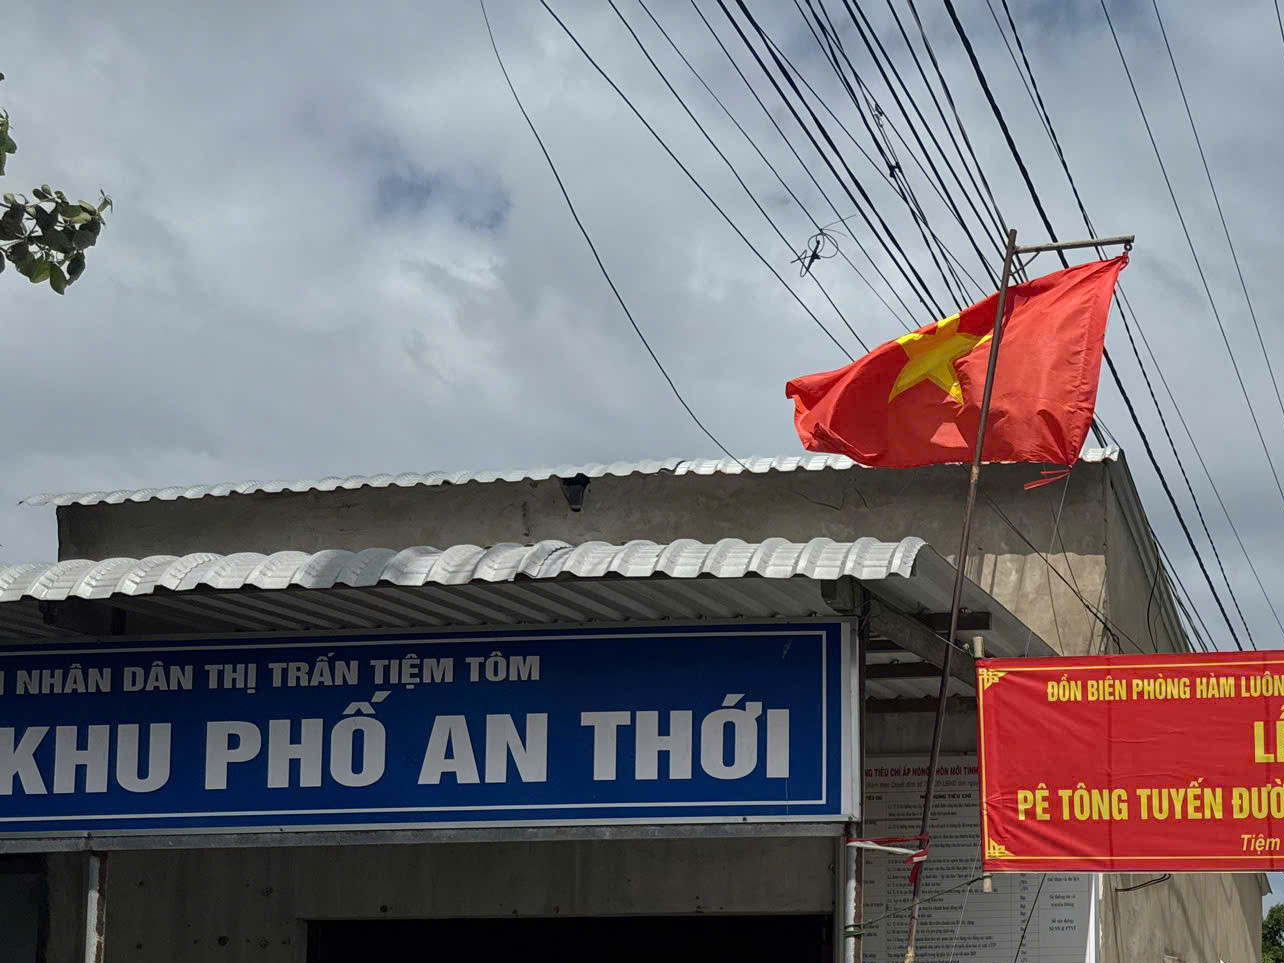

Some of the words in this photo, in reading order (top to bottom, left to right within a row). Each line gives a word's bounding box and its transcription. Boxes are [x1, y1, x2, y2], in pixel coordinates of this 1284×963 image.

[16, 663, 111, 695] NHÂN
[123, 659, 192, 692] DÂN
[205, 663, 257, 694] THỊ
[269, 652, 359, 687] TRẤN
[370, 652, 454, 689] TIỆM
[465, 652, 540, 682] TÔM
[1047, 673, 1082, 702] ĐỒN
[1087, 675, 1127, 702] BIÊN
[1131, 673, 1191, 700] PHÒNG
[1195, 672, 1236, 698] HÀM
[0, 723, 171, 795] KHU
[205, 691, 388, 790] PHỐ
[418, 713, 547, 785] AN
[581, 693, 790, 781] THỚI
[1017, 782, 1051, 821] PÊ
[1058, 782, 1128, 820] TÔNG
[1136, 777, 1223, 820] TUYẾN
[1240, 833, 1281, 852] Tiệm
